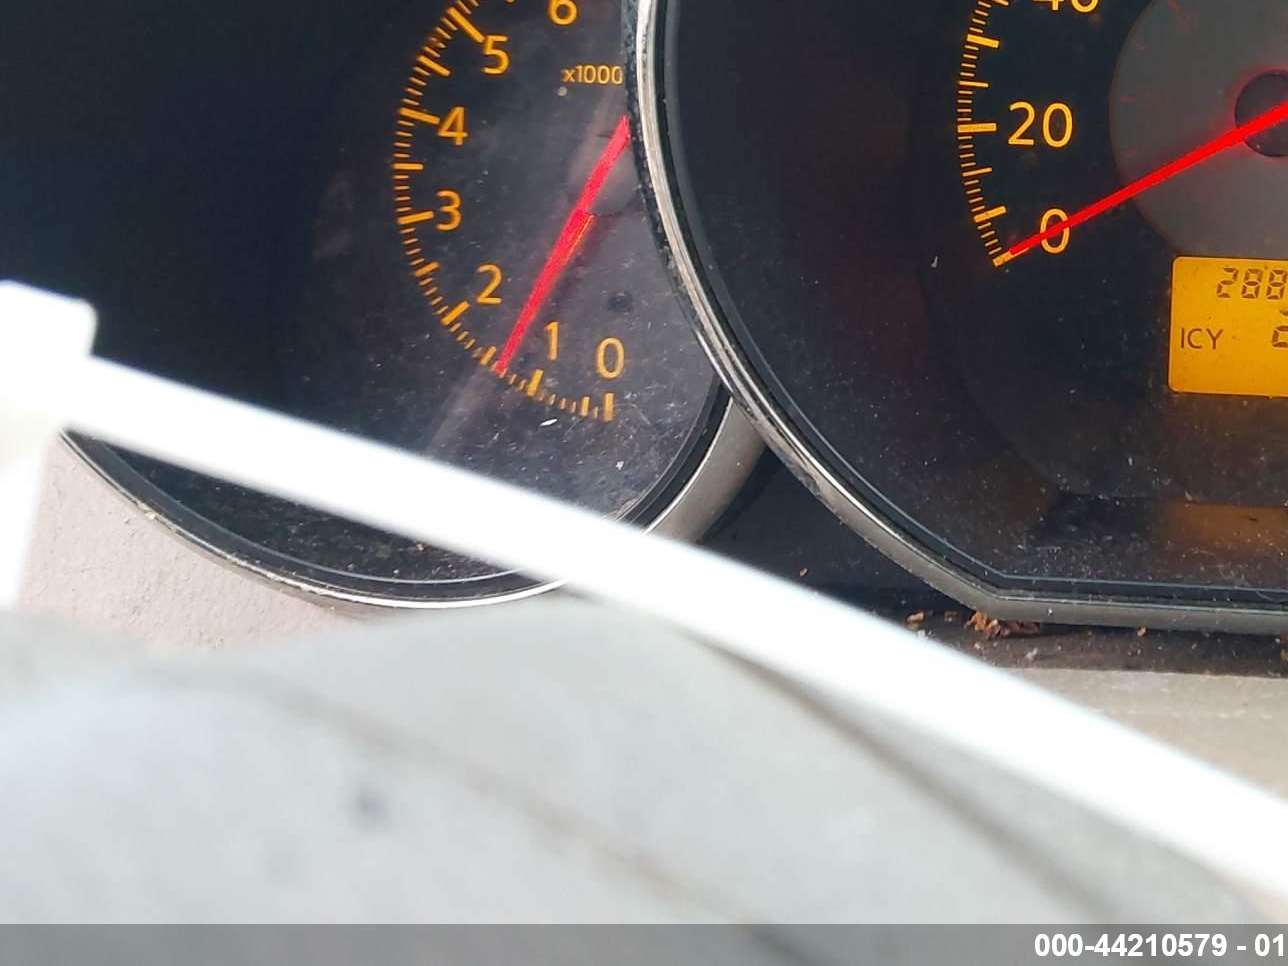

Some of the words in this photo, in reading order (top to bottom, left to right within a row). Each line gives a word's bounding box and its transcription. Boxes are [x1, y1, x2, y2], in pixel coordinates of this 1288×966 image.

[483, 35, 510, 75] 5
[562, 64, 624, 85] x1000
[438, 106, 468, 146] 4
[1007, 101, 1073, 148] 20
[436, 190, 462, 232] 3
[1039, 208, 1070, 254] 0
[475, 265, 503, 305] 2
[543, 321, 560, 362] 1
[595, 336, 625, 380] 0
[1180, 327, 1224, 350] ICY
